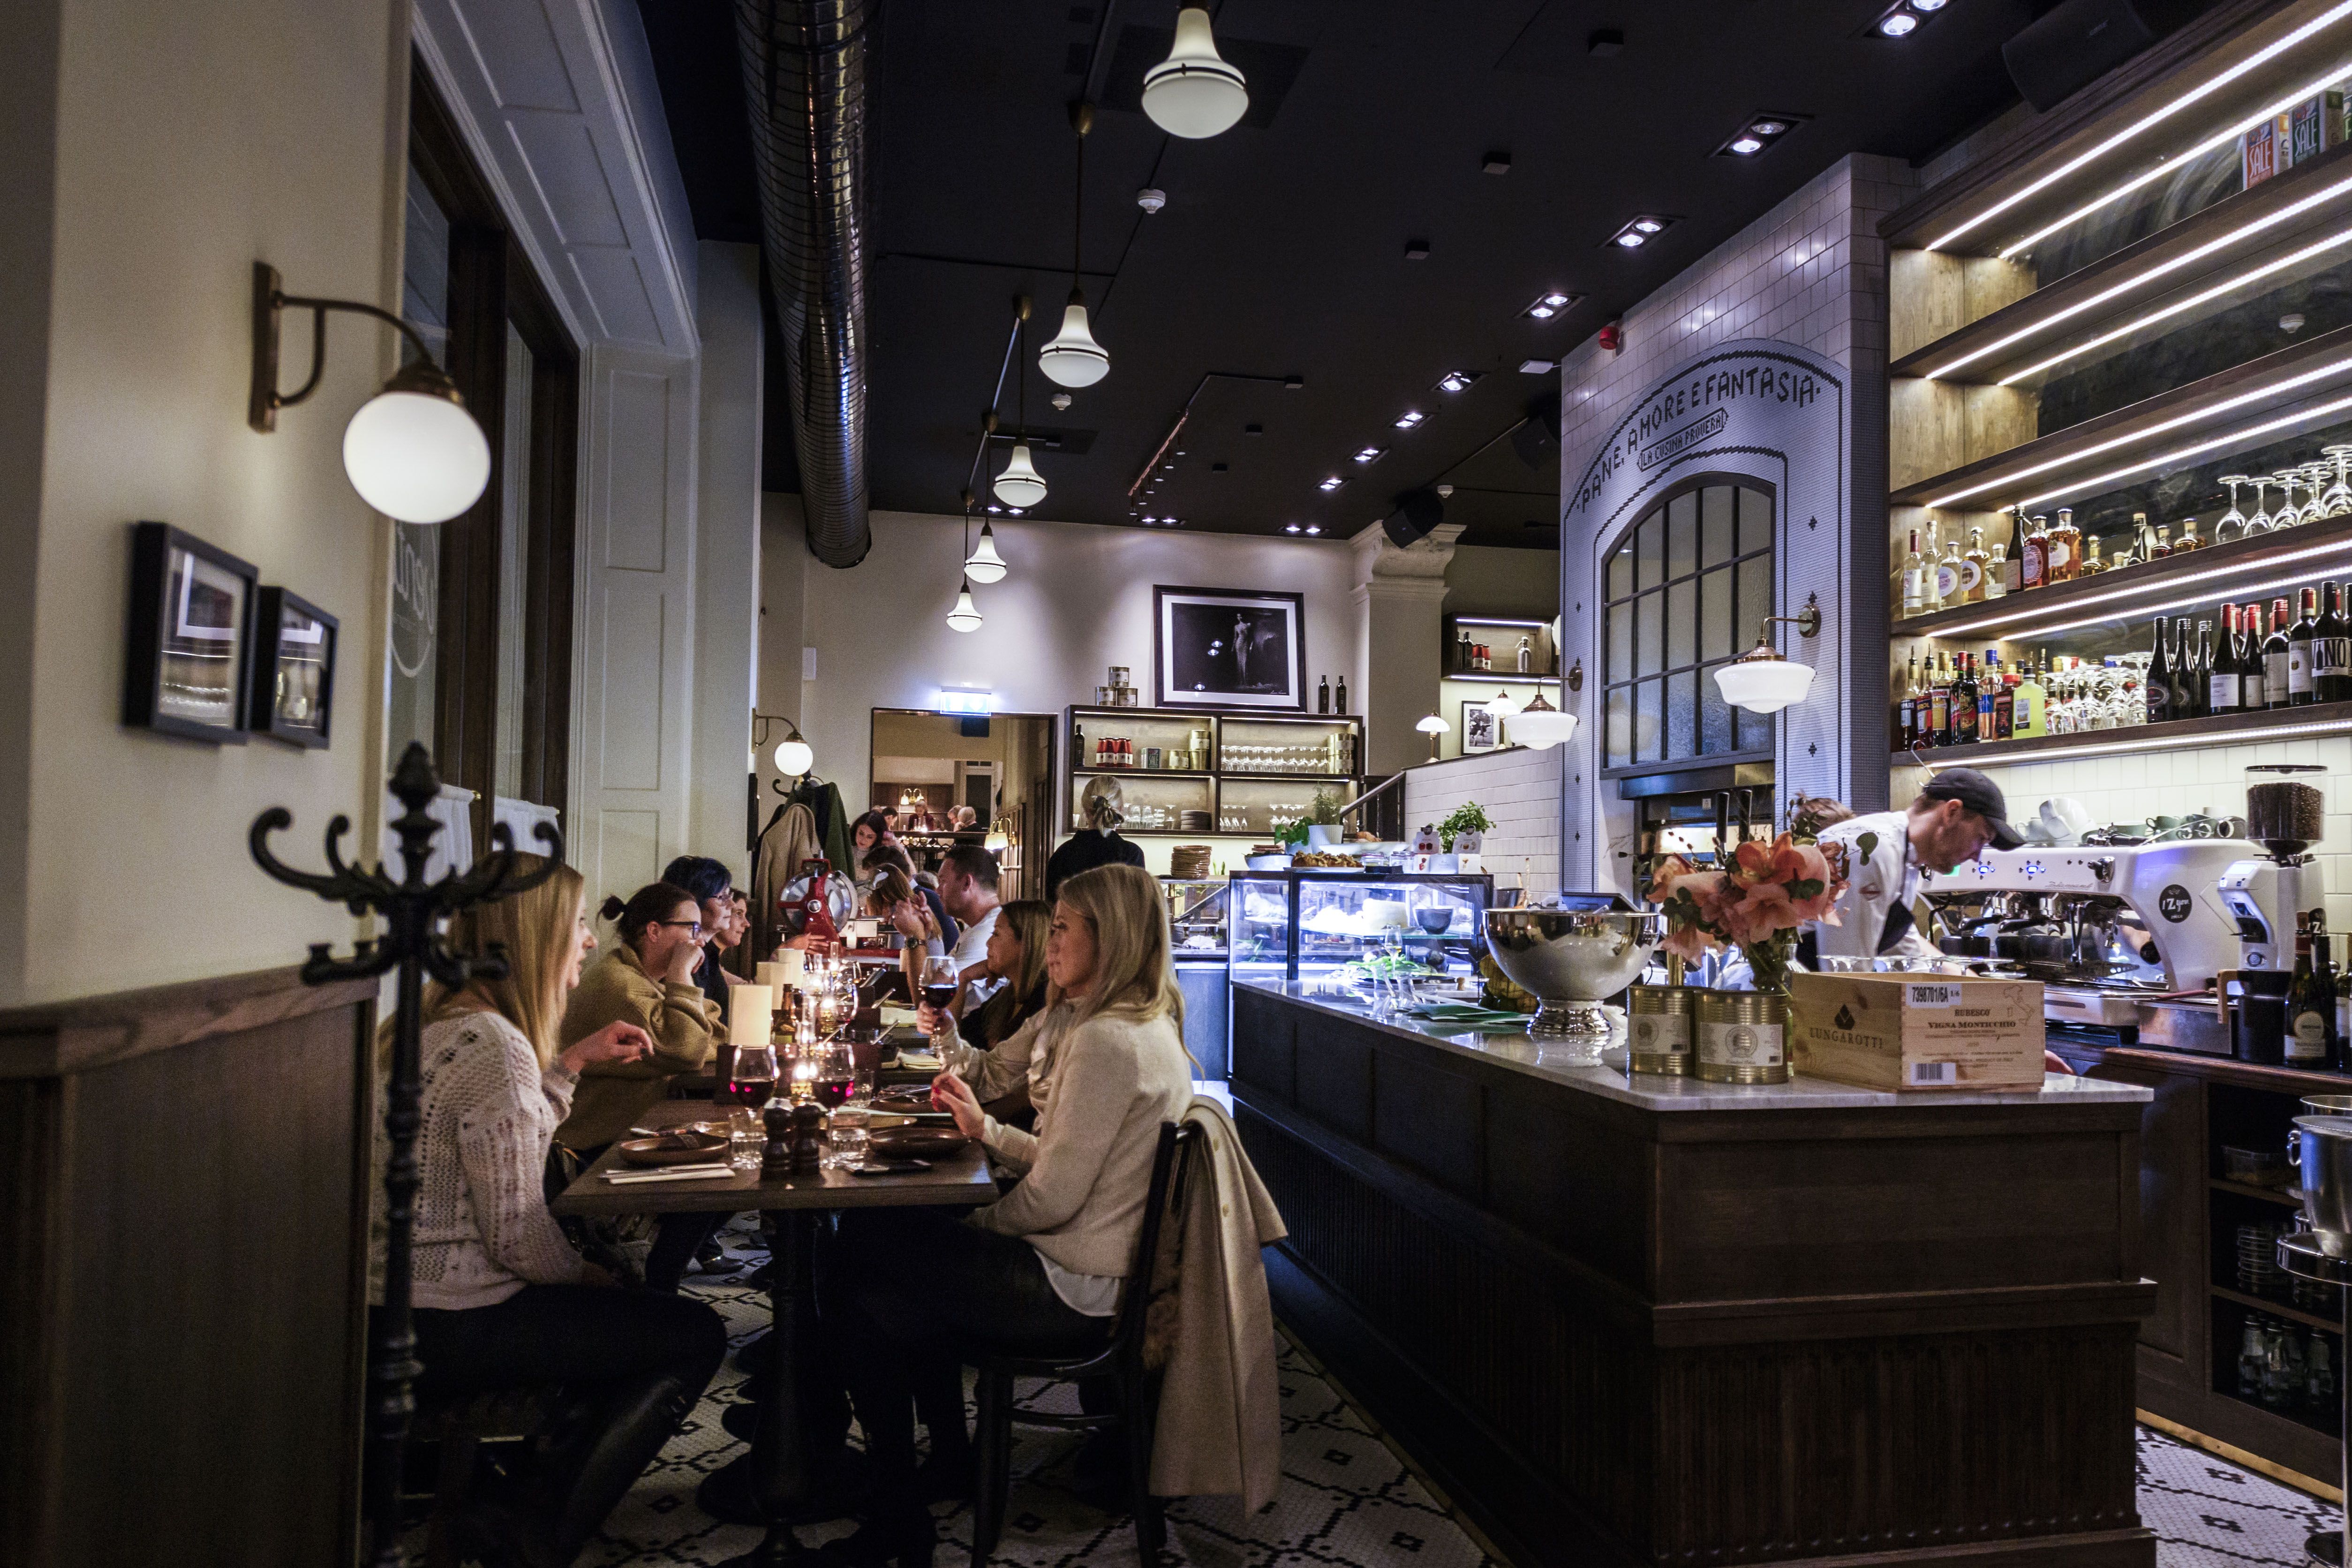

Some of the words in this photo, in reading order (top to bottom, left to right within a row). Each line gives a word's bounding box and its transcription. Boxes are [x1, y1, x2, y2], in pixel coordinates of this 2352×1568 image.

[2294, 116, 2317, 158] SALE
[2249, 140, 2271, 179] SALE
[1628, 390, 1686, 455] AMORE
[1691, 382, 1701, 408] E
[1643, 450, 1653, 467] LA
[1954, 1008, 1990, 1017] RUBESCO
[1959, 1020, 2016, 1029] MONTICCHIO
[1809, 1027, 1885, 1049] LUNGAROTTI
